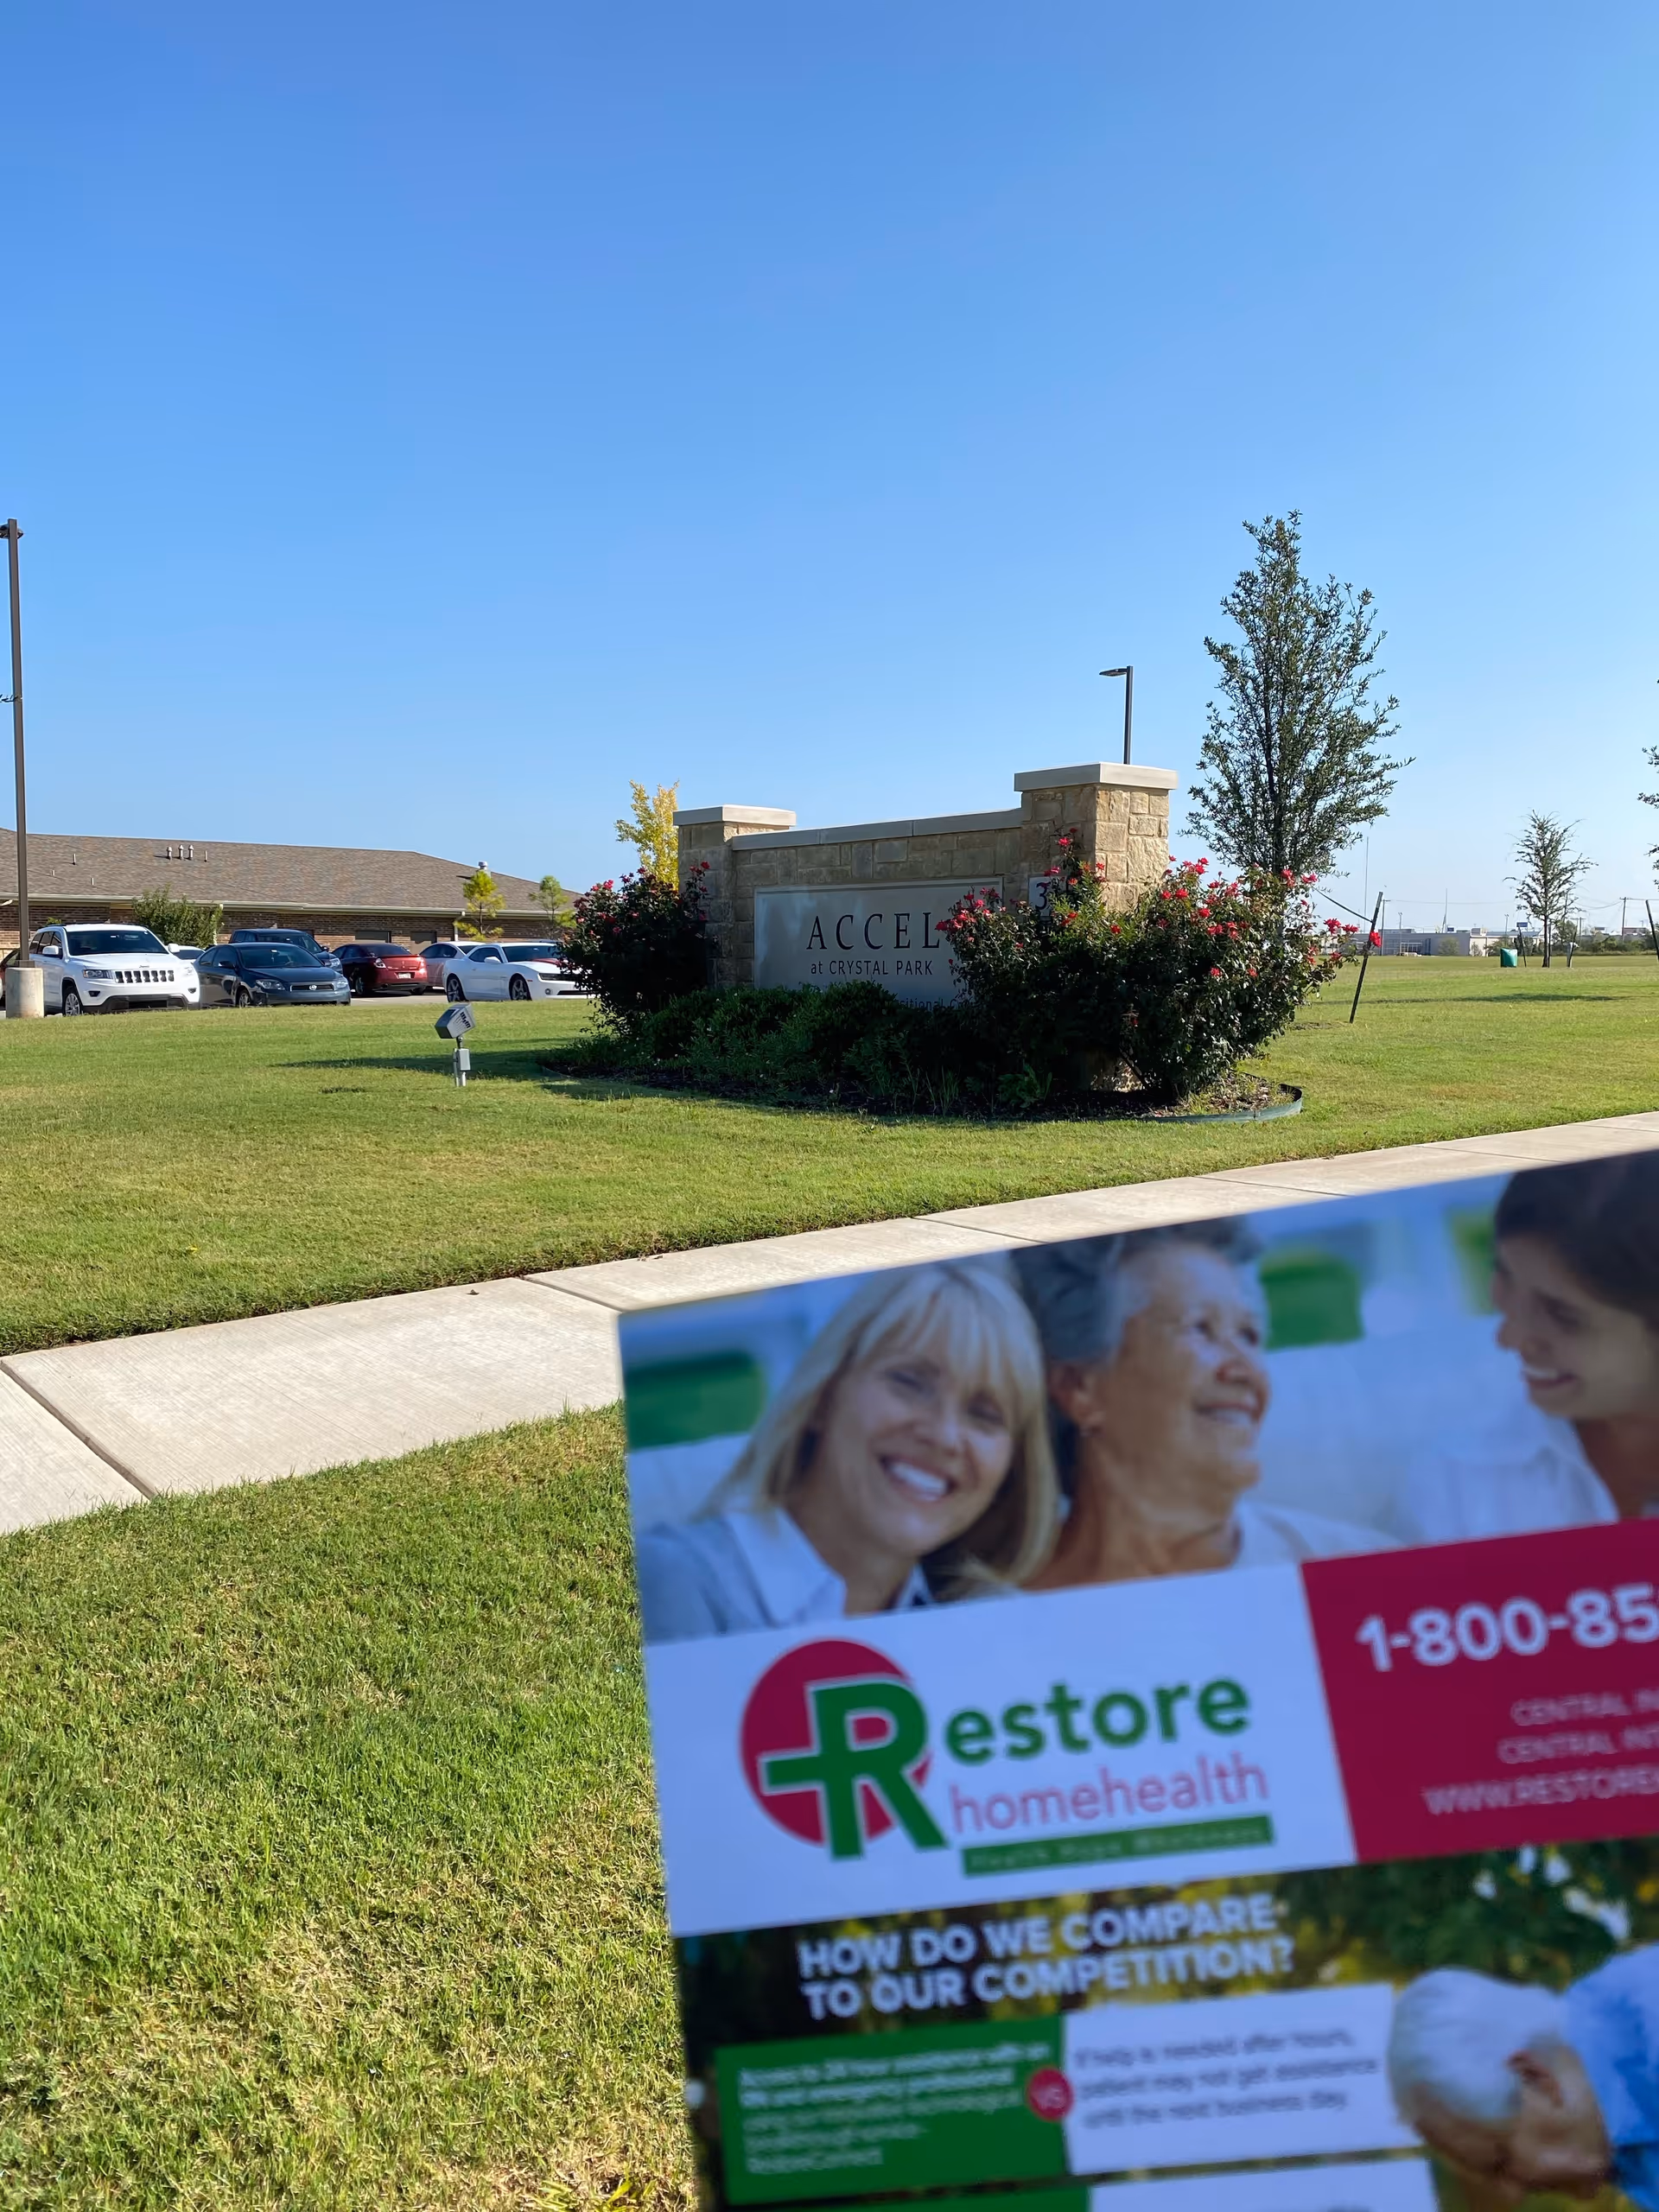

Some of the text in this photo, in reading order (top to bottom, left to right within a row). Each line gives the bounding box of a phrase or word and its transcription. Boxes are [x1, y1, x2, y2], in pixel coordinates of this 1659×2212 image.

[806, 912, 940, 950] ACCEL
[810, 960, 933, 976] at CRYSTAL PARK
[764, 1678, 1250, 1860] Restore
[951, 1751, 1268, 1834] homehealth
[797, 1891, 1276, 1980] HOW DO WE COMPARE
[800, 1936, 1294, 2022] TO OUR COMPETITION?
